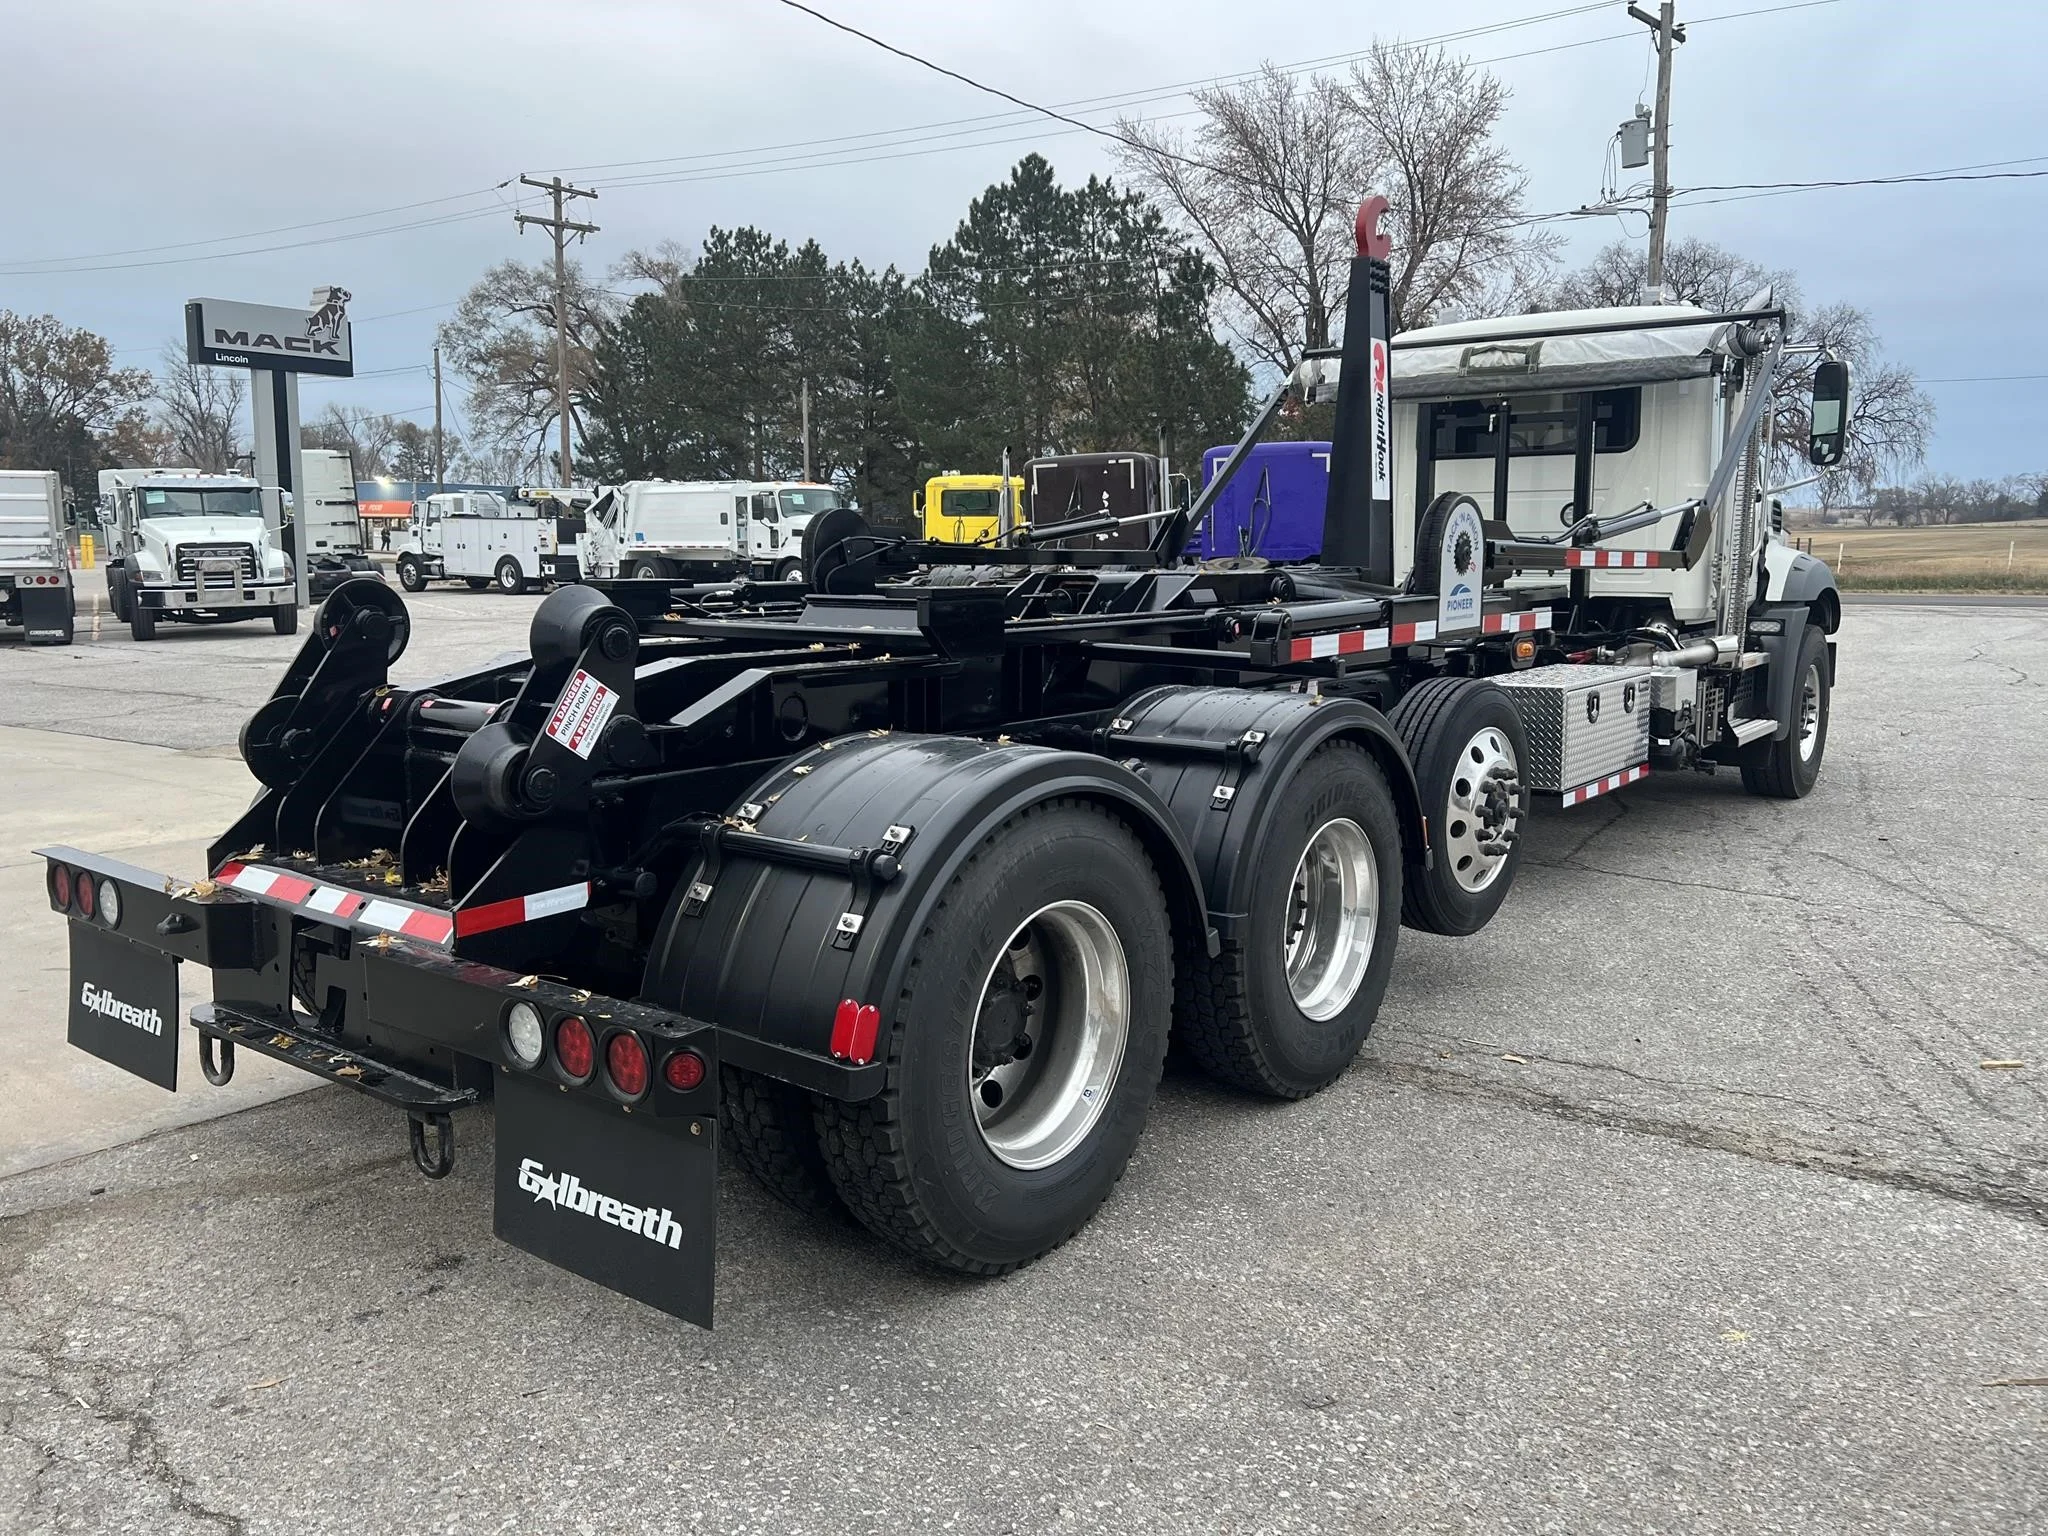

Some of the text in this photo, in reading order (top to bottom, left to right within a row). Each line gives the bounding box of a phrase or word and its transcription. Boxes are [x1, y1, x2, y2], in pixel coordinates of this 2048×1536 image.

[215, 329, 339, 355] MACK
[216, 353, 248, 363] Lincoln
[1447, 519, 1459, 553] RACK
[1466, 514, 1479, 551] PINION
[1447, 598, 1473, 611] PIONEER
[557, 678, 582, 720] DANGER
[560, 683, 592, 737] PINCH POINT
[577, 691, 604, 736] PELIGRO
